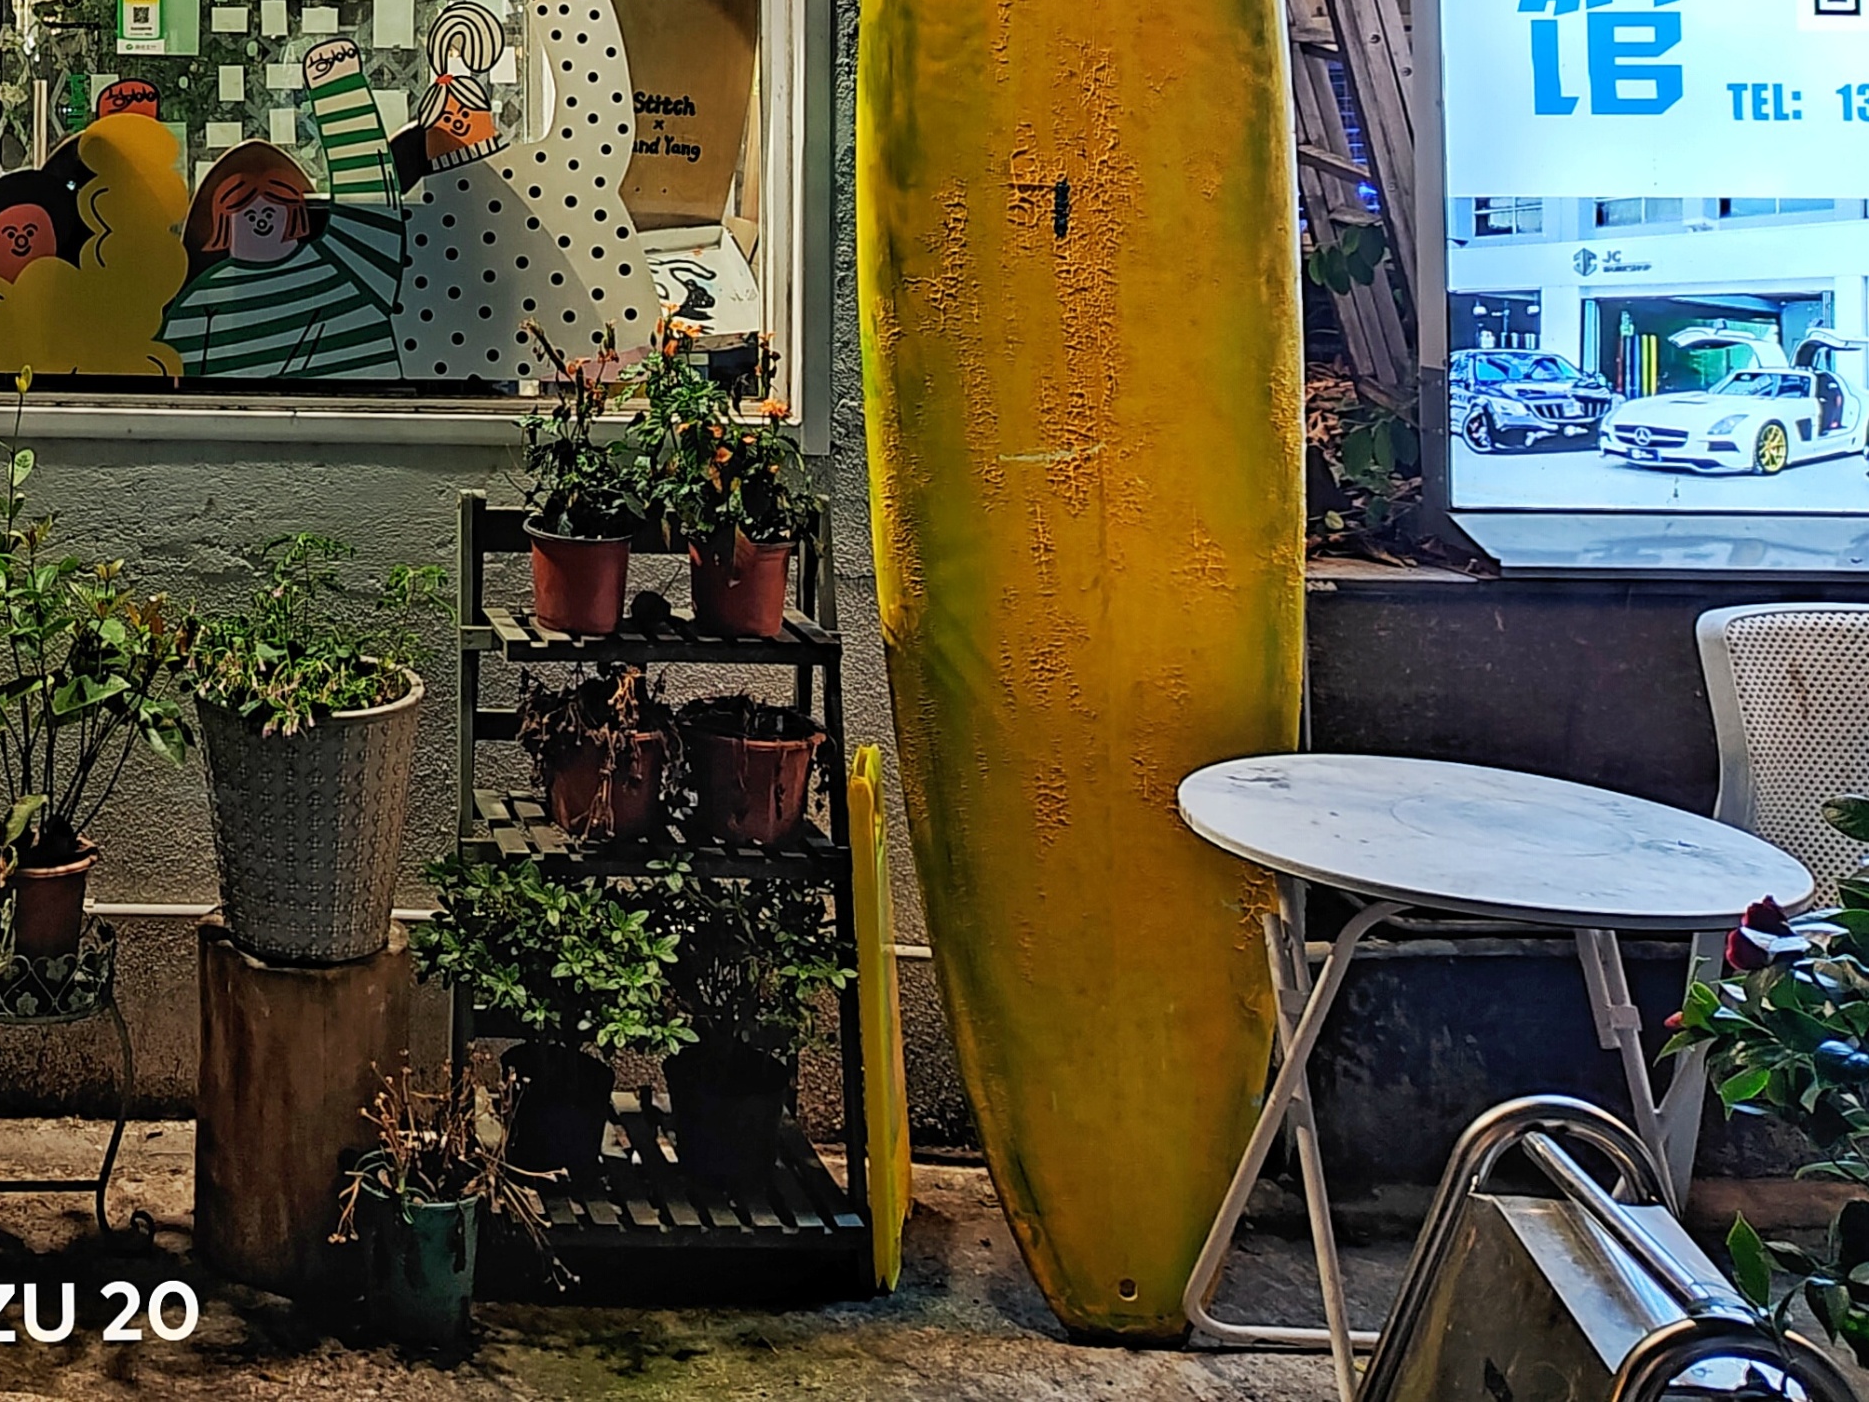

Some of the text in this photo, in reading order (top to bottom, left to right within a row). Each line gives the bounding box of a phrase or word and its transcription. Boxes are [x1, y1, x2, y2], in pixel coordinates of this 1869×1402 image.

[633, 91, 696, 116] Stitch
[1726, 83, 1802, 120] TEL:
[633, 134, 701, 163] nd Yang
